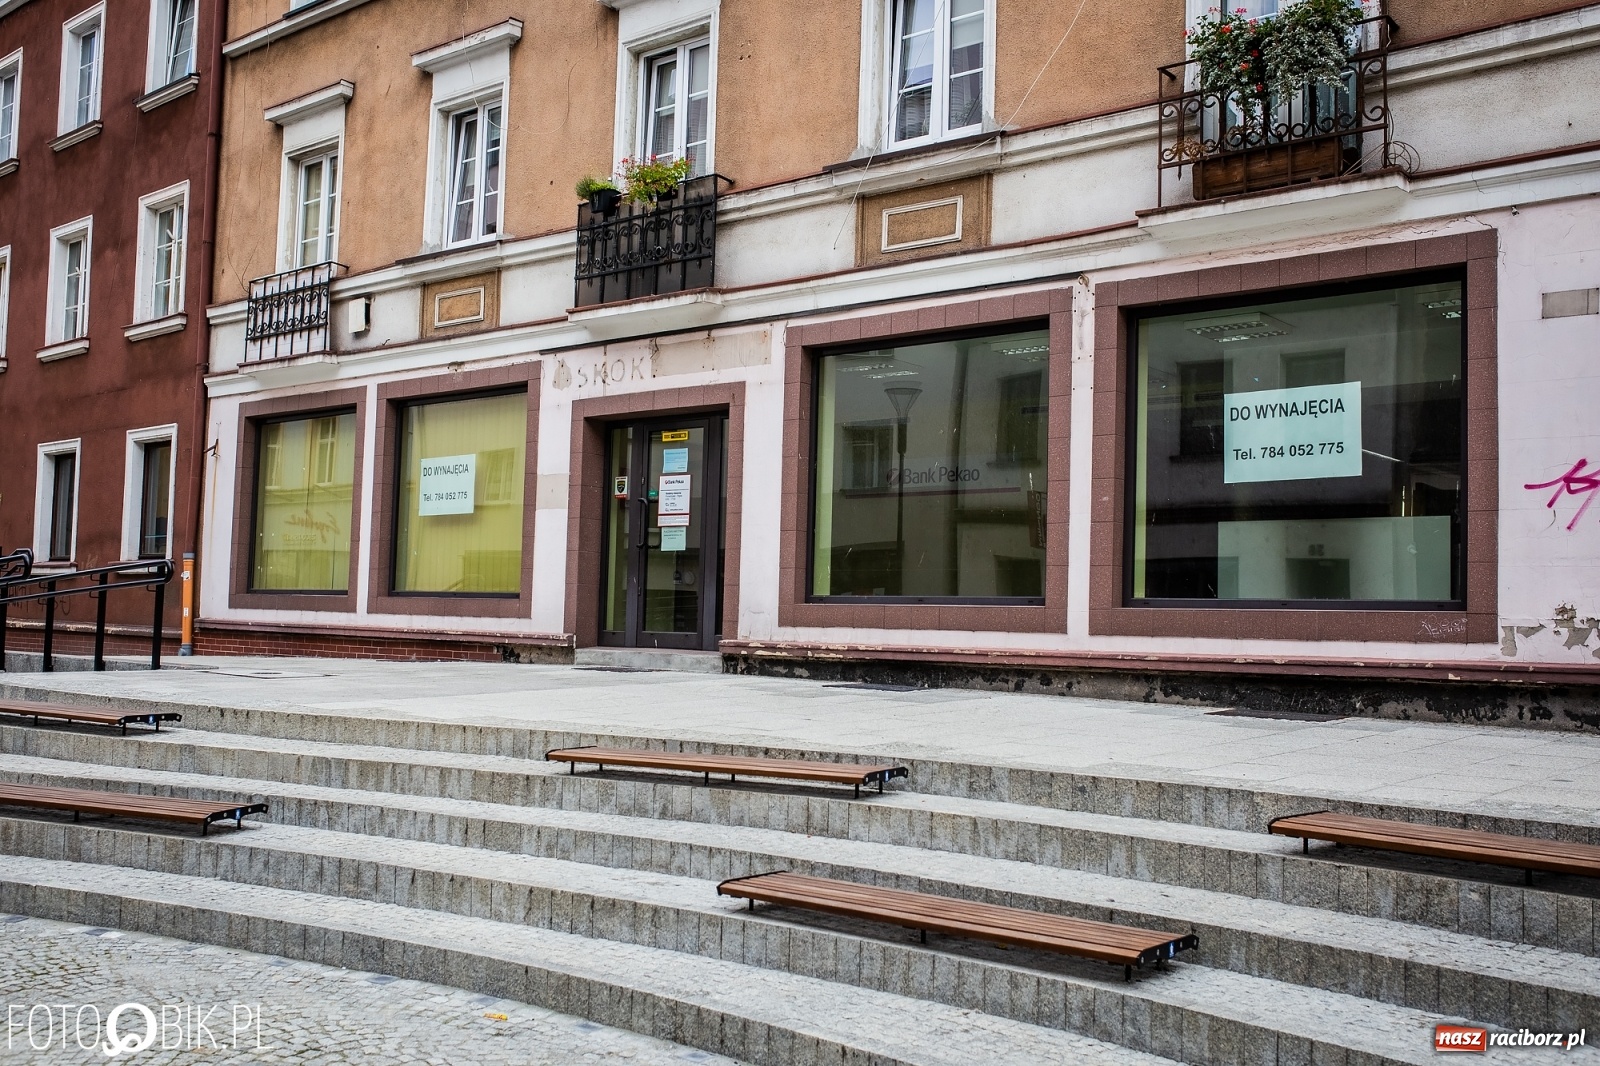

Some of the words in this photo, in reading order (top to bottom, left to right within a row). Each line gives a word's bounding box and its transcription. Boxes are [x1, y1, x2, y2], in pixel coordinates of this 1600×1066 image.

[1230, 406, 1250, 421] DO
[1255, 398, 1345, 418] WYNAJĘCIA
[1233, 448, 1256, 460] Tel.
[1260, 446, 1285, 458] 784
[1289, 444, 1314, 457] 052
[1319, 442, 1344, 454] 775
[423, 466, 432, 477] DO
[434, 464, 469, 476] WYNAJĘCIA
[903, 467, 935, 484] Bank
[939, 466, 980, 483] Pekao
[423, 493, 433, 501] Tel.
[435, 493, 444, 501] 784
[445, 492, 456, 500] 052
[457, 491, 467, 499] 775
